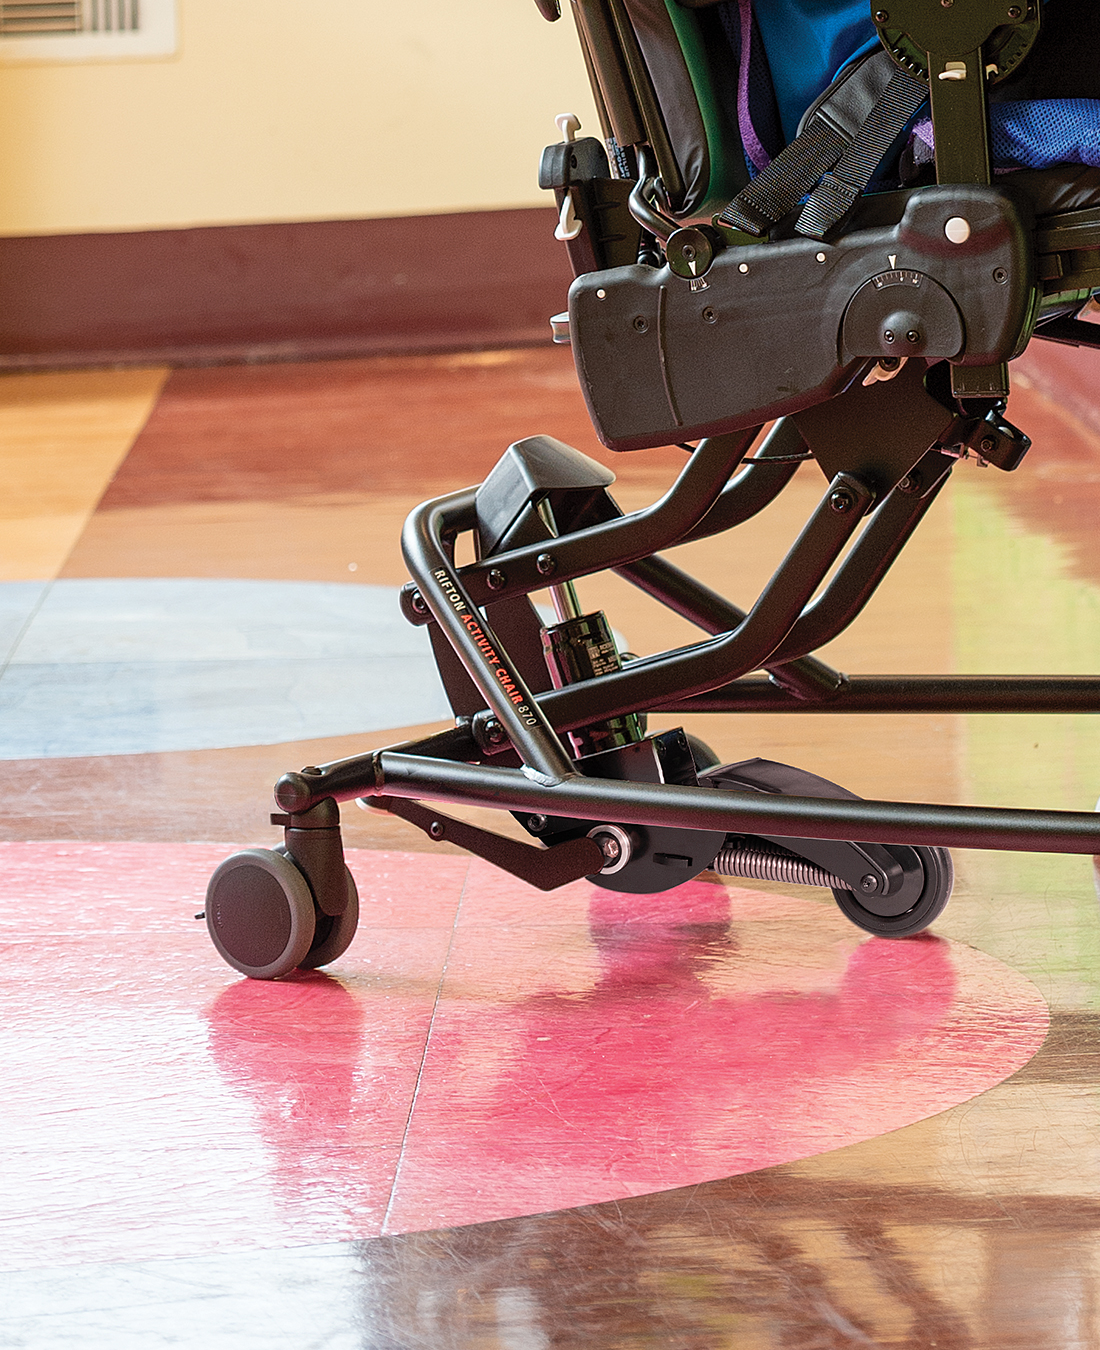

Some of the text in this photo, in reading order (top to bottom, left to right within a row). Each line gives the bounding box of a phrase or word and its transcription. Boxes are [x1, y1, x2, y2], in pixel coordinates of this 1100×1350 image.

[434, 569, 537, 726] RIFTON ACTIVITY CHAIR 870
